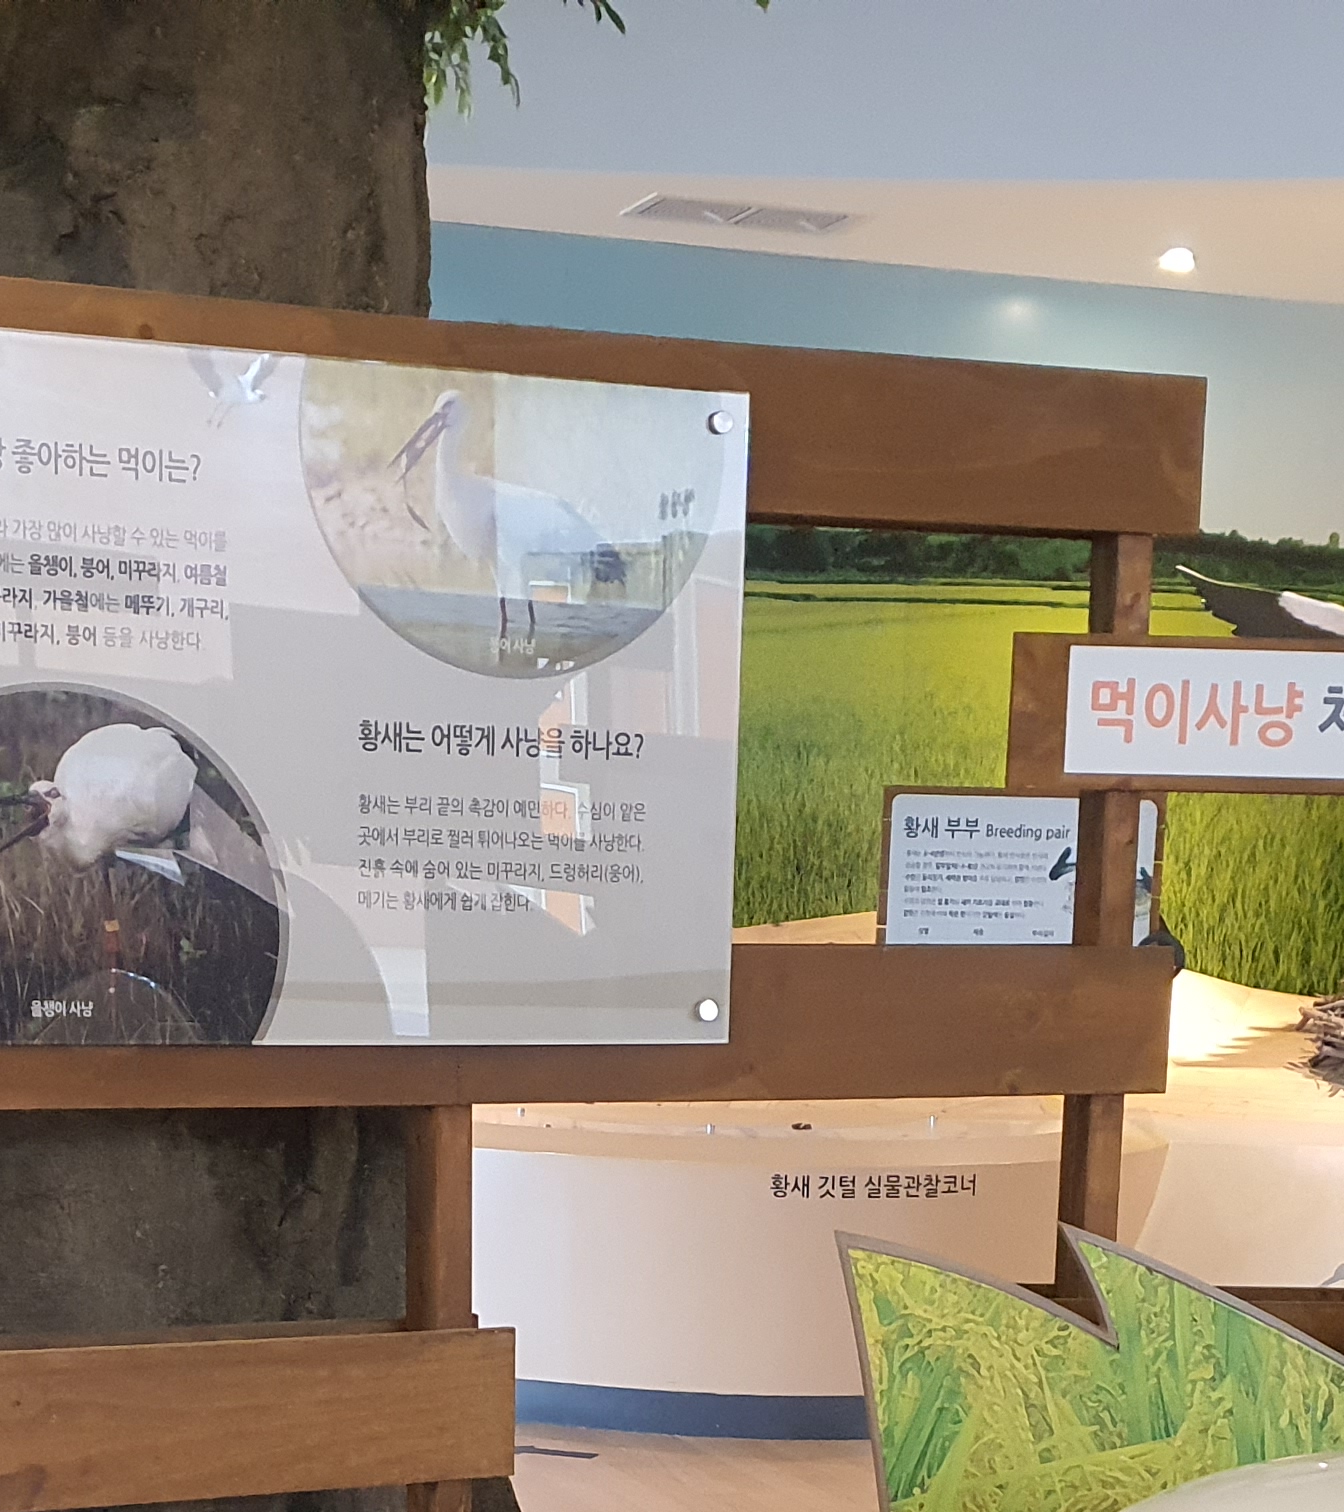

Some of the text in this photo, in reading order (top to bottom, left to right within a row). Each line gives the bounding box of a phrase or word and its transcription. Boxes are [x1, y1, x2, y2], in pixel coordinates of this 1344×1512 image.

[11, 437, 112, 478] 좋아하는
[118, 446, 202, 484] 먹이는?
[13, 519, 44, 541] 가장
[47, 520, 78, 543] 많이
[81, 523, 127, 547] 사냥할
[131, 527, 147, 546] 수
[150, 527, 180, 549] 있는
[184, 529, 229, 552] 먹이를
[28, 552, 77, 579] 올챙이,
[80, 556, 115, 581] 붕어,
[184, 563, 228, 587] 여름철
[43, 589, 121, 614] 가을철에는
[124, 594, 175, 618] 메뚜기,
[179, 597, 229, 621] 개구리,
[66, 624, 98, 647] 붕어
[103, 627, 133, 649] 등을
[1090, 677, 1304, 748] 먹이사냥
[358, 719, 645, 760] 황새는 어떻게 사냥을 하나요?
[358, 793, 401, 815] 황새는
[404, 795, 432, 816] 부리
[437, 796, 464, 817] 끝의
[468, 797, 510, 818] 촉감이
[577, 801, 616, 822] 수심이
[619, 802, 647, 822] 얕은
[357, 825, 645, 853] 곳에서 부리로 찔러 튀어나오는 먹이를 사냥한다.
[903, 815, 1071, 841] 황새 부부 Breeding pair
[358, 858, 645, 884] 진흙 속에 숨어 있는 미꾸라지, 드렁허리(웅어),
[358, 890, 399, 910] 메기는
[403, 890, 458, 911] 황새에게
[460, 892, 487, 912] 쉽게
[30, 999, 94, 1018] 올챙이 사냥
[770, 1173, 977, 1199] 황새 깃털 실물관찰코너
